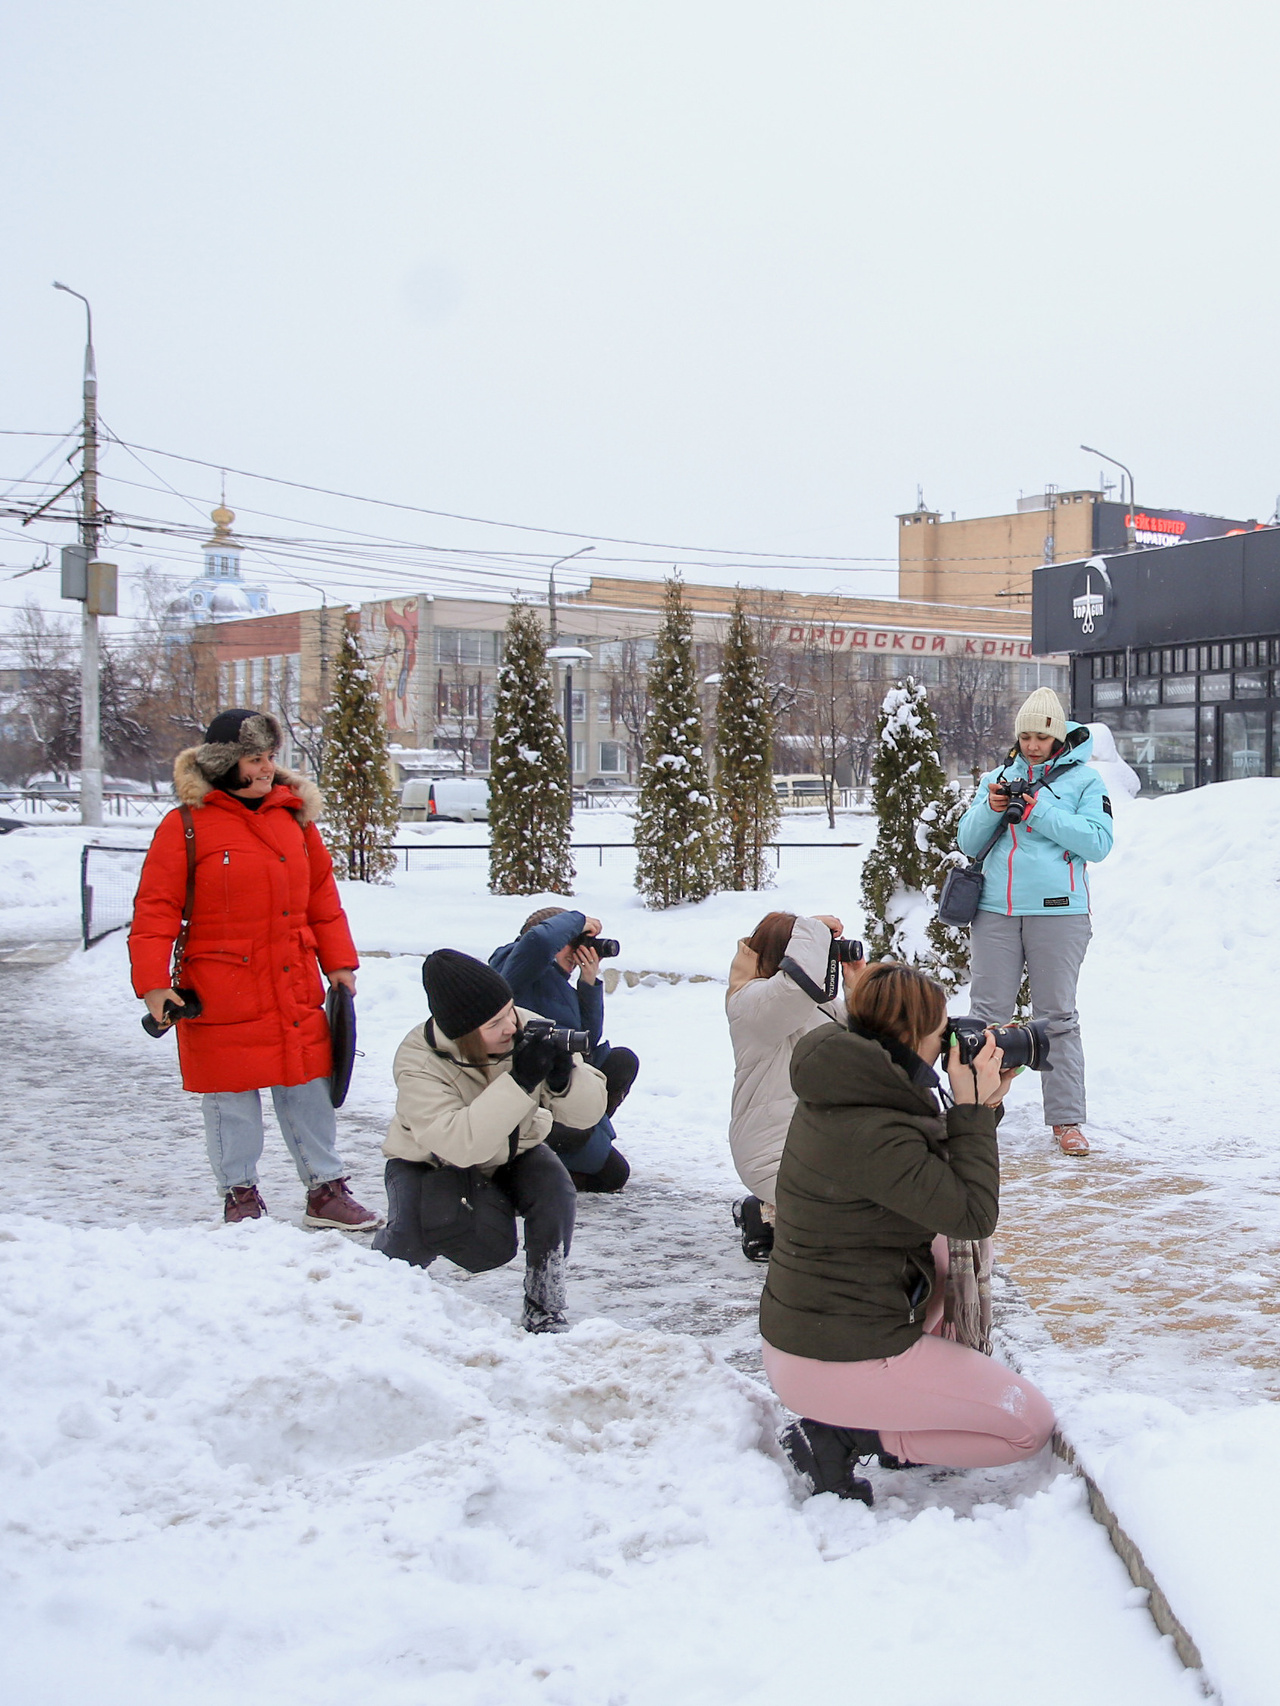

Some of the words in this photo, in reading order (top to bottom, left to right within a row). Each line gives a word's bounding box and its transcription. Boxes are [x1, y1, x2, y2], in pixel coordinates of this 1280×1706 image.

[1124, 513, 1151, 531] СЕЙК
[1157, 518, 1187, 535] БУРГЕР
[1073, 605, 1086, 619] TOP
[1091, 603, 1104, 617] GUN
[769, 626, 946, 652] ГОРОДСКОЙ
[828, 974, 836, 997] DIGITAL
